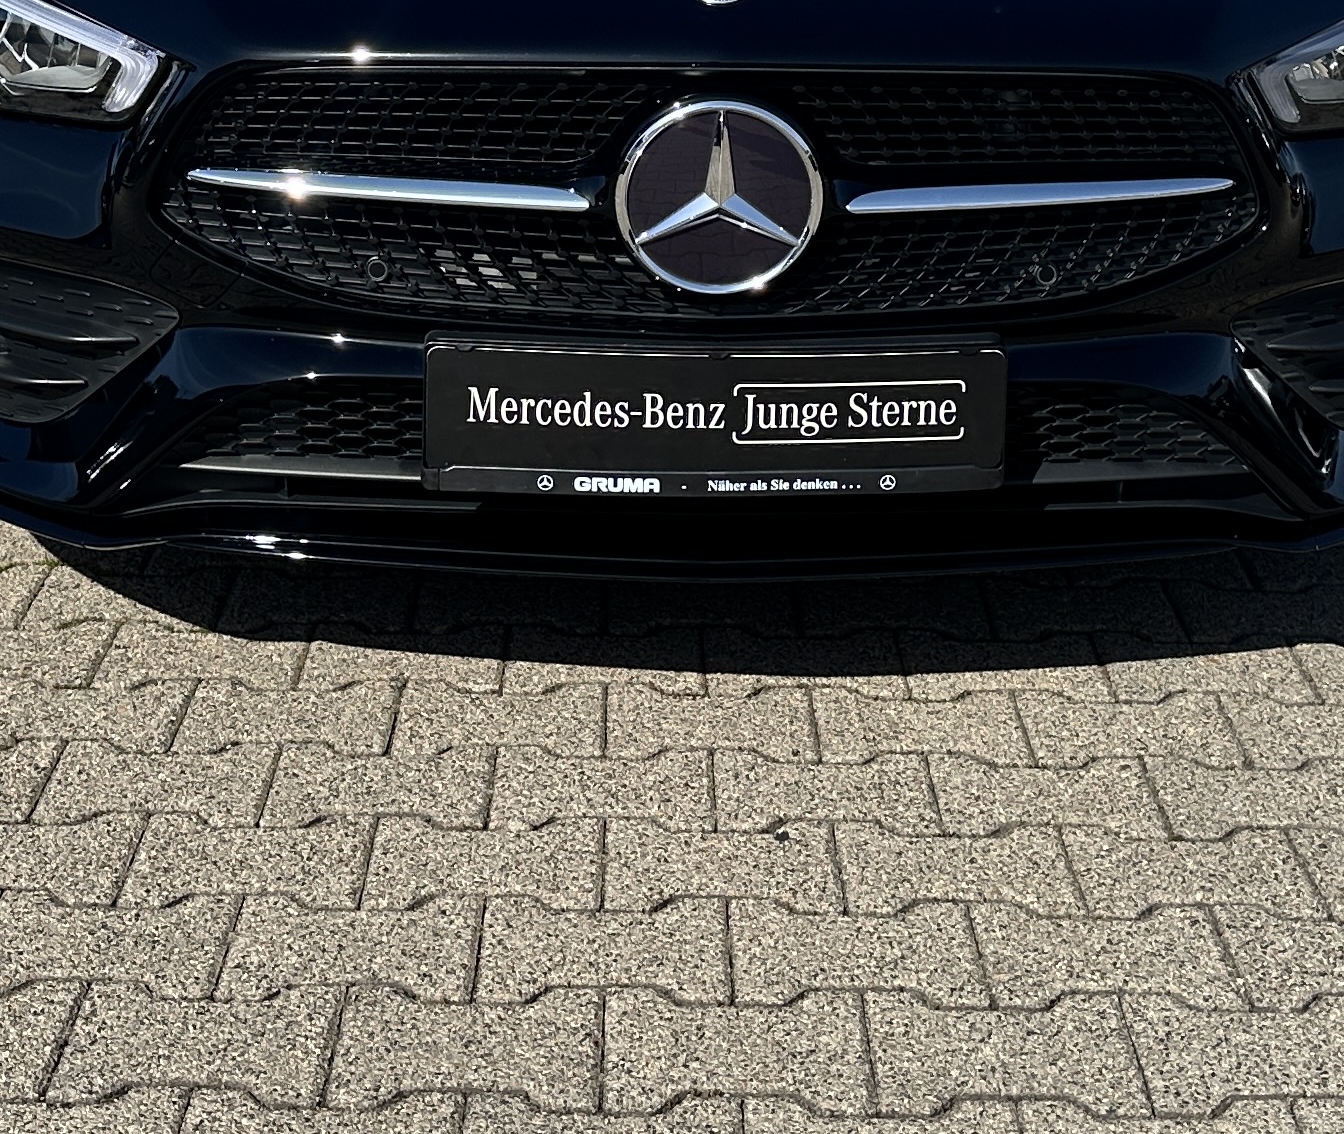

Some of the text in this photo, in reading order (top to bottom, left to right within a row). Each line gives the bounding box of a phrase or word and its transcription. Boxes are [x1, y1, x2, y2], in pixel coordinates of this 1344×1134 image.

[466, 386, 957, 437] Mercedes-Benz Junge Sterne
[573, 476, 660, 493] GRUMA
[707, 480, 747, 492] Näher
[749, 479, 768, 491] als
[770, 478, 790, 491] Sie
